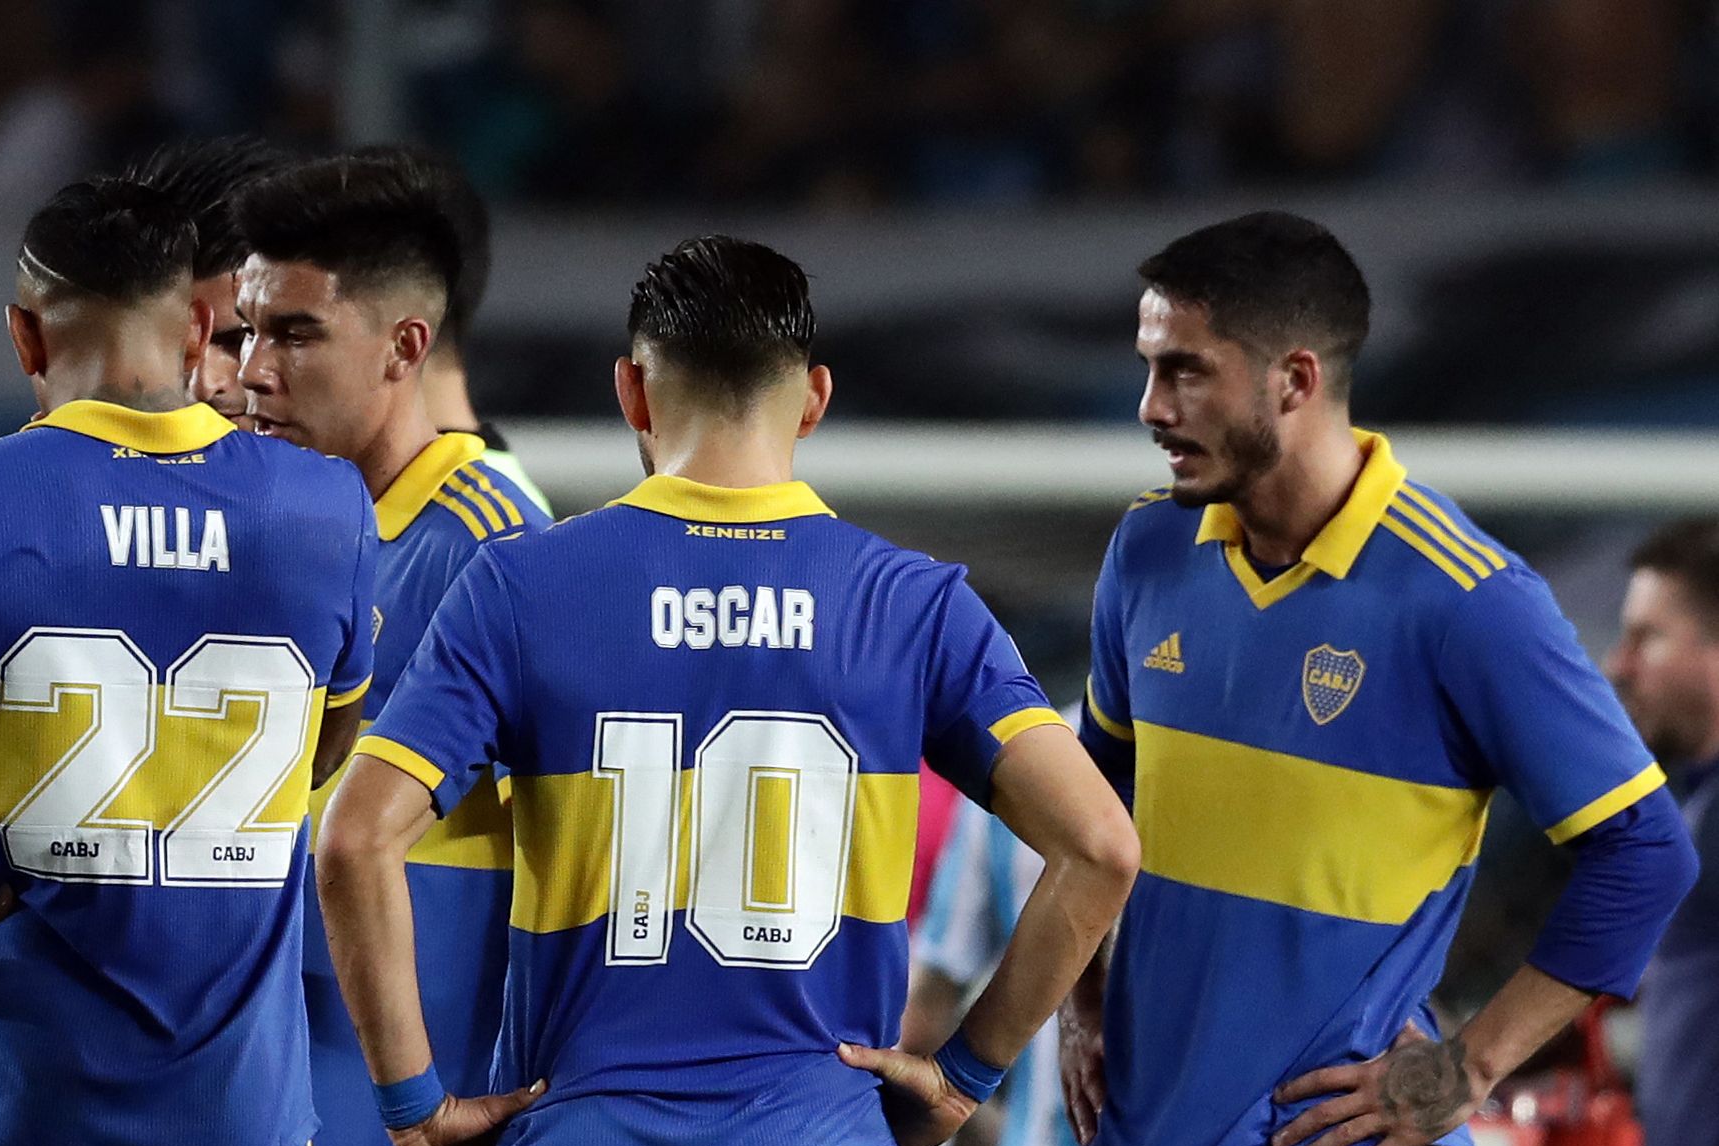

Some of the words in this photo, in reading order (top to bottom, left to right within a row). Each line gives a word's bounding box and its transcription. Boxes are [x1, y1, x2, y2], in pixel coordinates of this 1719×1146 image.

[99, 504, 231, 572] VILLA
[684, 524, 787, 541] XENEIZE
[650, 585, 815, 651] OSCAR
[1309, 667, 1354, 692] CABJ
[50, 841, 100, 859] CABJ
[591, 709, 859, 971] 10
[212, 846, 256, 863] CABJ
[632, 889, 651, 940] CABJ
[742, 925, 793, 945] CABJ
